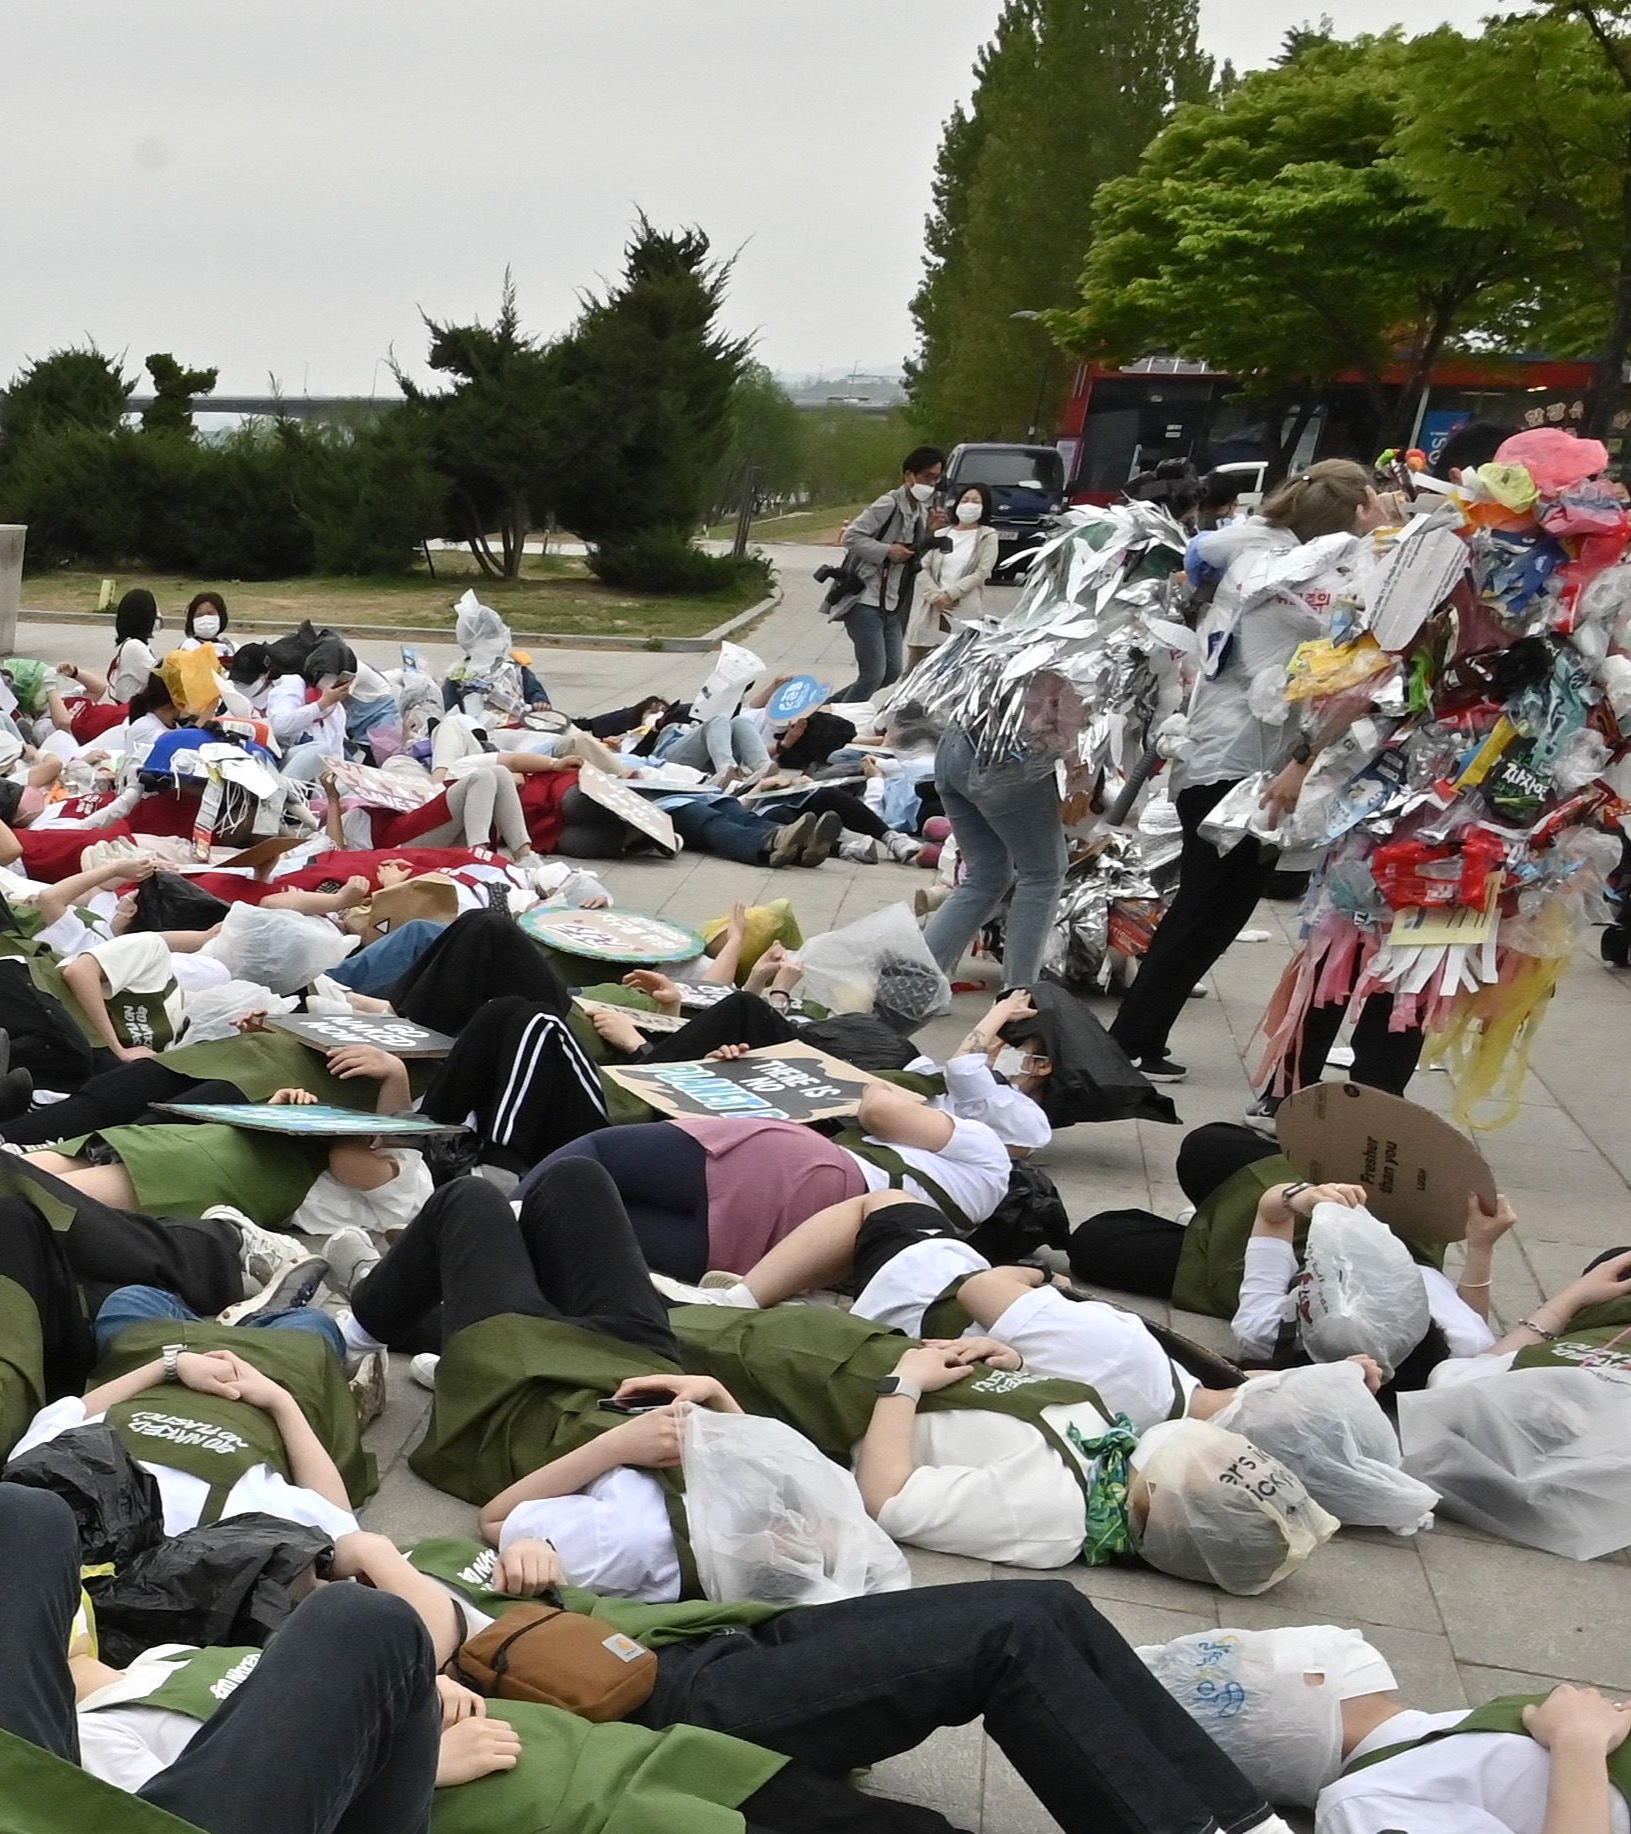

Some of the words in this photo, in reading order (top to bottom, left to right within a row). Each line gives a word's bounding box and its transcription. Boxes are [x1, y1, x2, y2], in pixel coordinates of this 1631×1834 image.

[323, 1016, 417, 1047] NAKED
[383, 1023, 429, 1038] GO
[749, 1075, 786, 1092] NO
[750, 1059, 810, 1087] THERE
[805, 1081, 840, 1098] IS
[1360, 1136, 1378, 1185] Fresher
[1384, 1141, 1399, 1166] you
[1380, 1167, 1395, 1193] than
